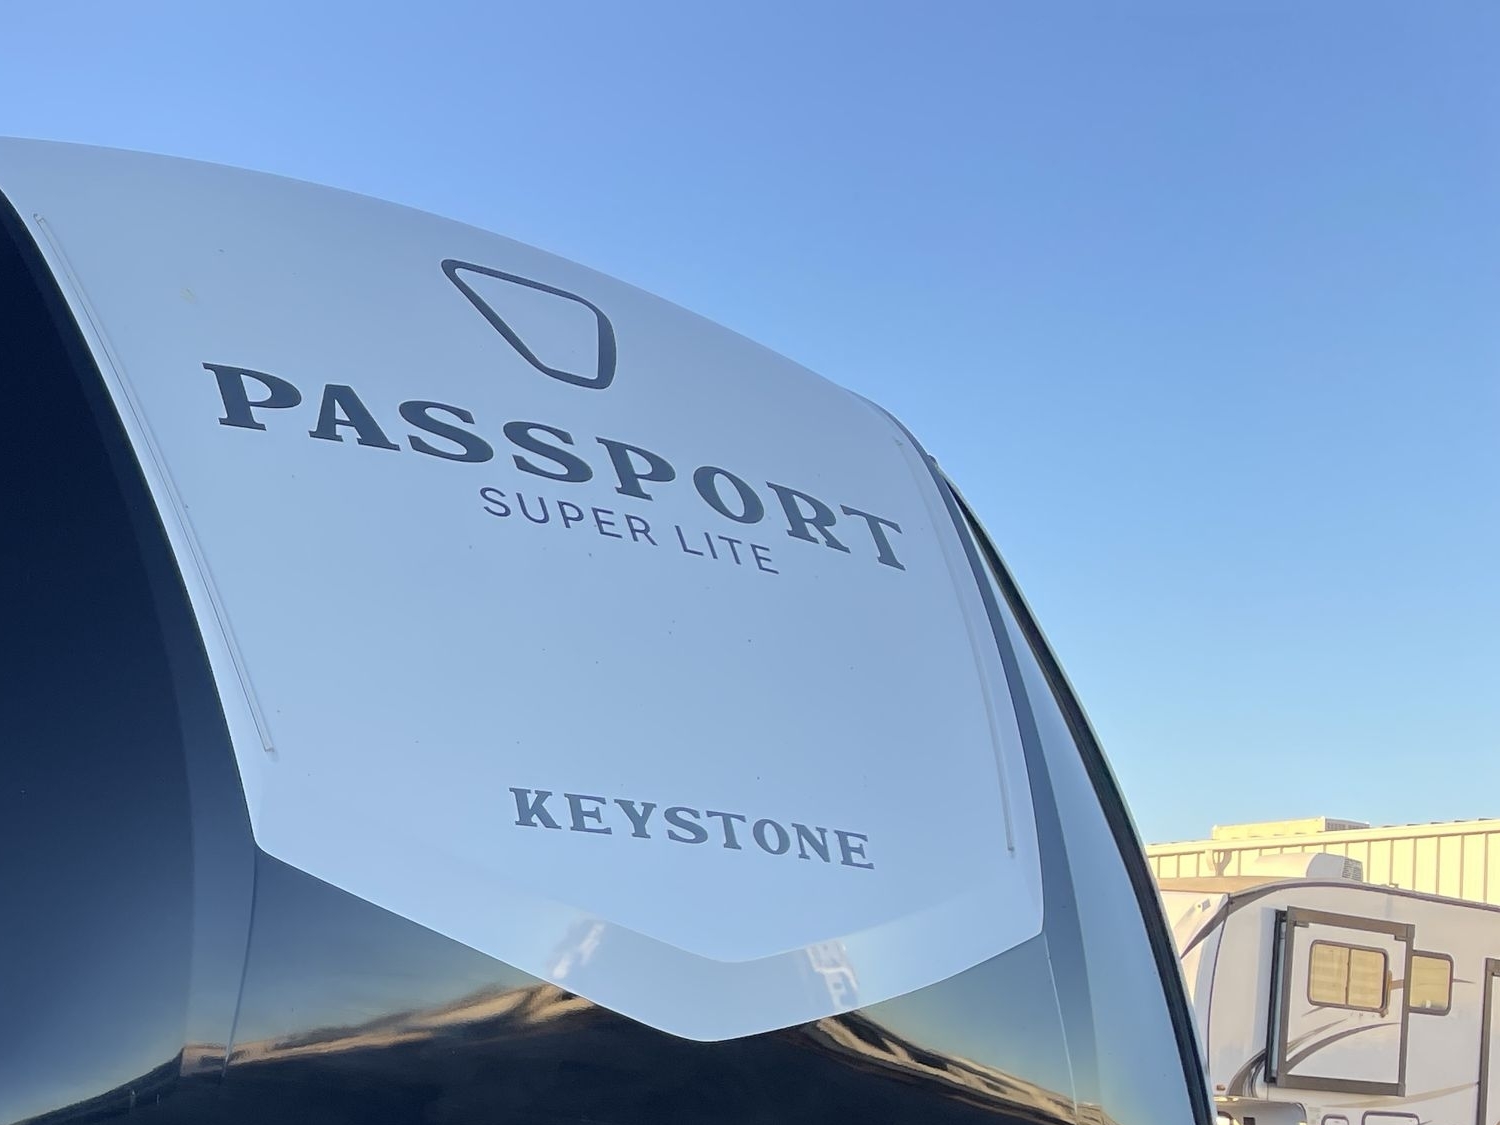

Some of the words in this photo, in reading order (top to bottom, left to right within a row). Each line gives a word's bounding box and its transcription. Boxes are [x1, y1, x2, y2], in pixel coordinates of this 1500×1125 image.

[202, 362, 907, 571] PASSPORT
[482, 486, 658, 546] SUPER
[674, 524, 780, 575] LITE
[509, 786, 875, 870] KEYSTONE
